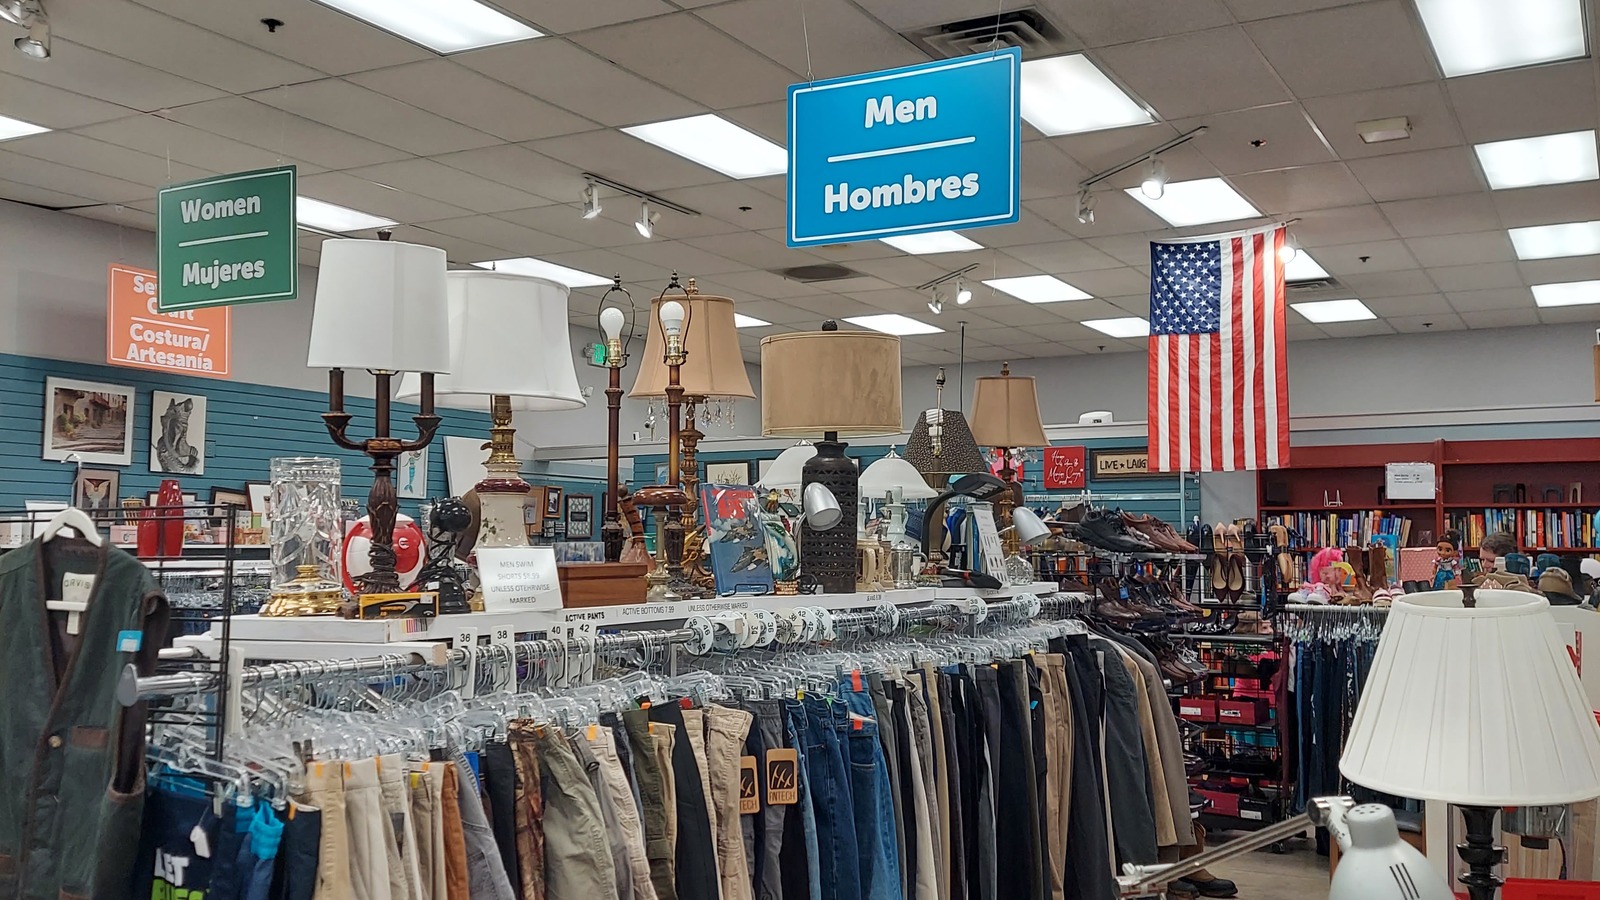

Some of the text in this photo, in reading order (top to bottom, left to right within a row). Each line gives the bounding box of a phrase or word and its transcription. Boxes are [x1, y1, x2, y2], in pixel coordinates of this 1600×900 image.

[864, 95, 937, 128] Men
[824, 172, 979, 213] Hombres
[180, 195, 261, 223] Women
[182, 260, 265, 289] Mujeres
[129, 323, 210, 351] Costura/
[126, 343, 213, 371] Artesanía
[1100, 459, 1147, 470] LIVE LAUG
[515, 560, 534, 568] SWIM
[64, 578, 90, 589] ORVIS
[491, 584, 514, 592] UNLESS
[509, 596, 536, 604] MARKED
[622, 606, 640, 615] ACTIVE
[640, 605, 664, 614] BOTTOMS
[687, 604, 705, 612] UNLESS
[565, 612, 605, 622] ACTIVE PANTS
[551, 626, 561, 635] 40
[580, 623, 590, 633] 42
[460, 633, 471, 643] 36
[497, 630, 508, 639] 38
[769, 791, 796, 801] FINTECH
[740, 799, 758, 810] TECH
